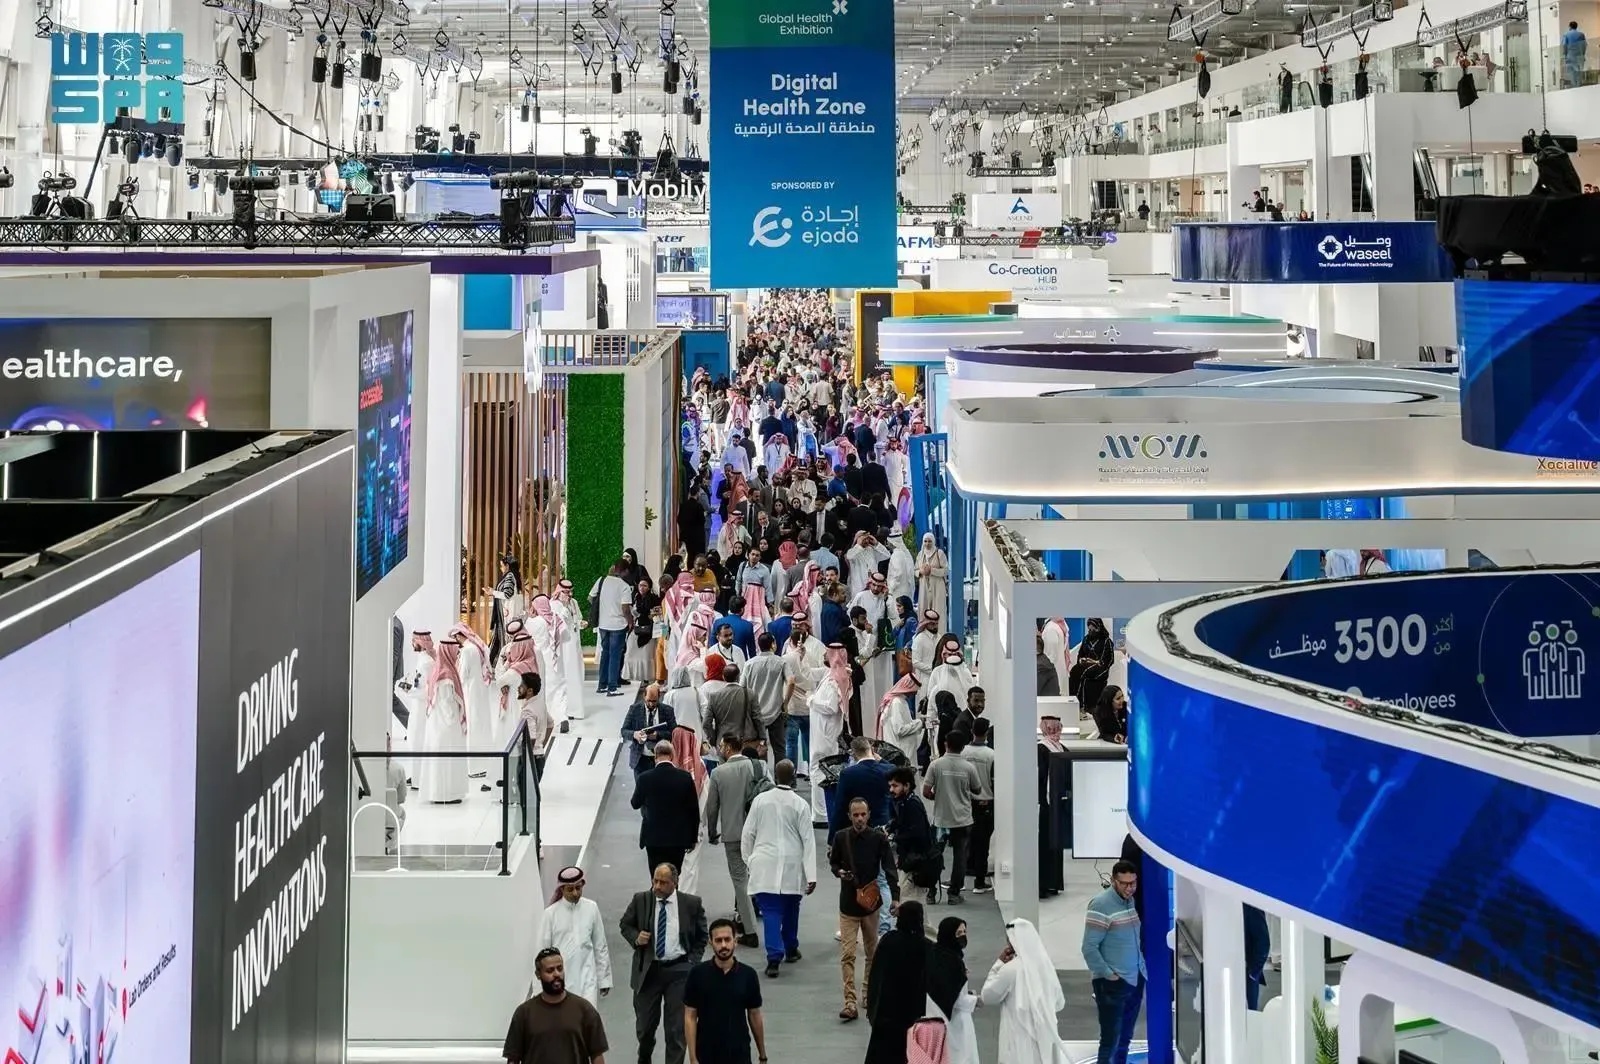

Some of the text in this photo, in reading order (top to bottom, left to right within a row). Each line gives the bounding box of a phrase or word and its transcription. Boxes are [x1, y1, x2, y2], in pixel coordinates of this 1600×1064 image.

[758, 13, 833, 24] Global Health
[780, 25, 833, 35] Exhibition
[771, 72, 838, 95] Digital
[743, 97, 866, 116] Health Zone
[734, 121, 875, 138] منطقة الصحة الرقمية
[627, 178, 708, 205] Mobily
[771, 181, 835, 190] SPONSORED BY
[801, 205, 859, 228] إجادة
[801, 226, 859, 247] ejada
[1344, 247, 1392, 260] waseel
[988, 263, 1058, 275] Co-Creation
[1038, 275, 1057, 284] HUB
[2, 348, 183, 382] ealthcare,
[1334, 613, 1427, 664] 3500
[237, 648, 298, 774] DRIVING
[234, 731, 325, 902] HEALTHCARE
[231, 835, 327, 1031] INNOVATIONS
